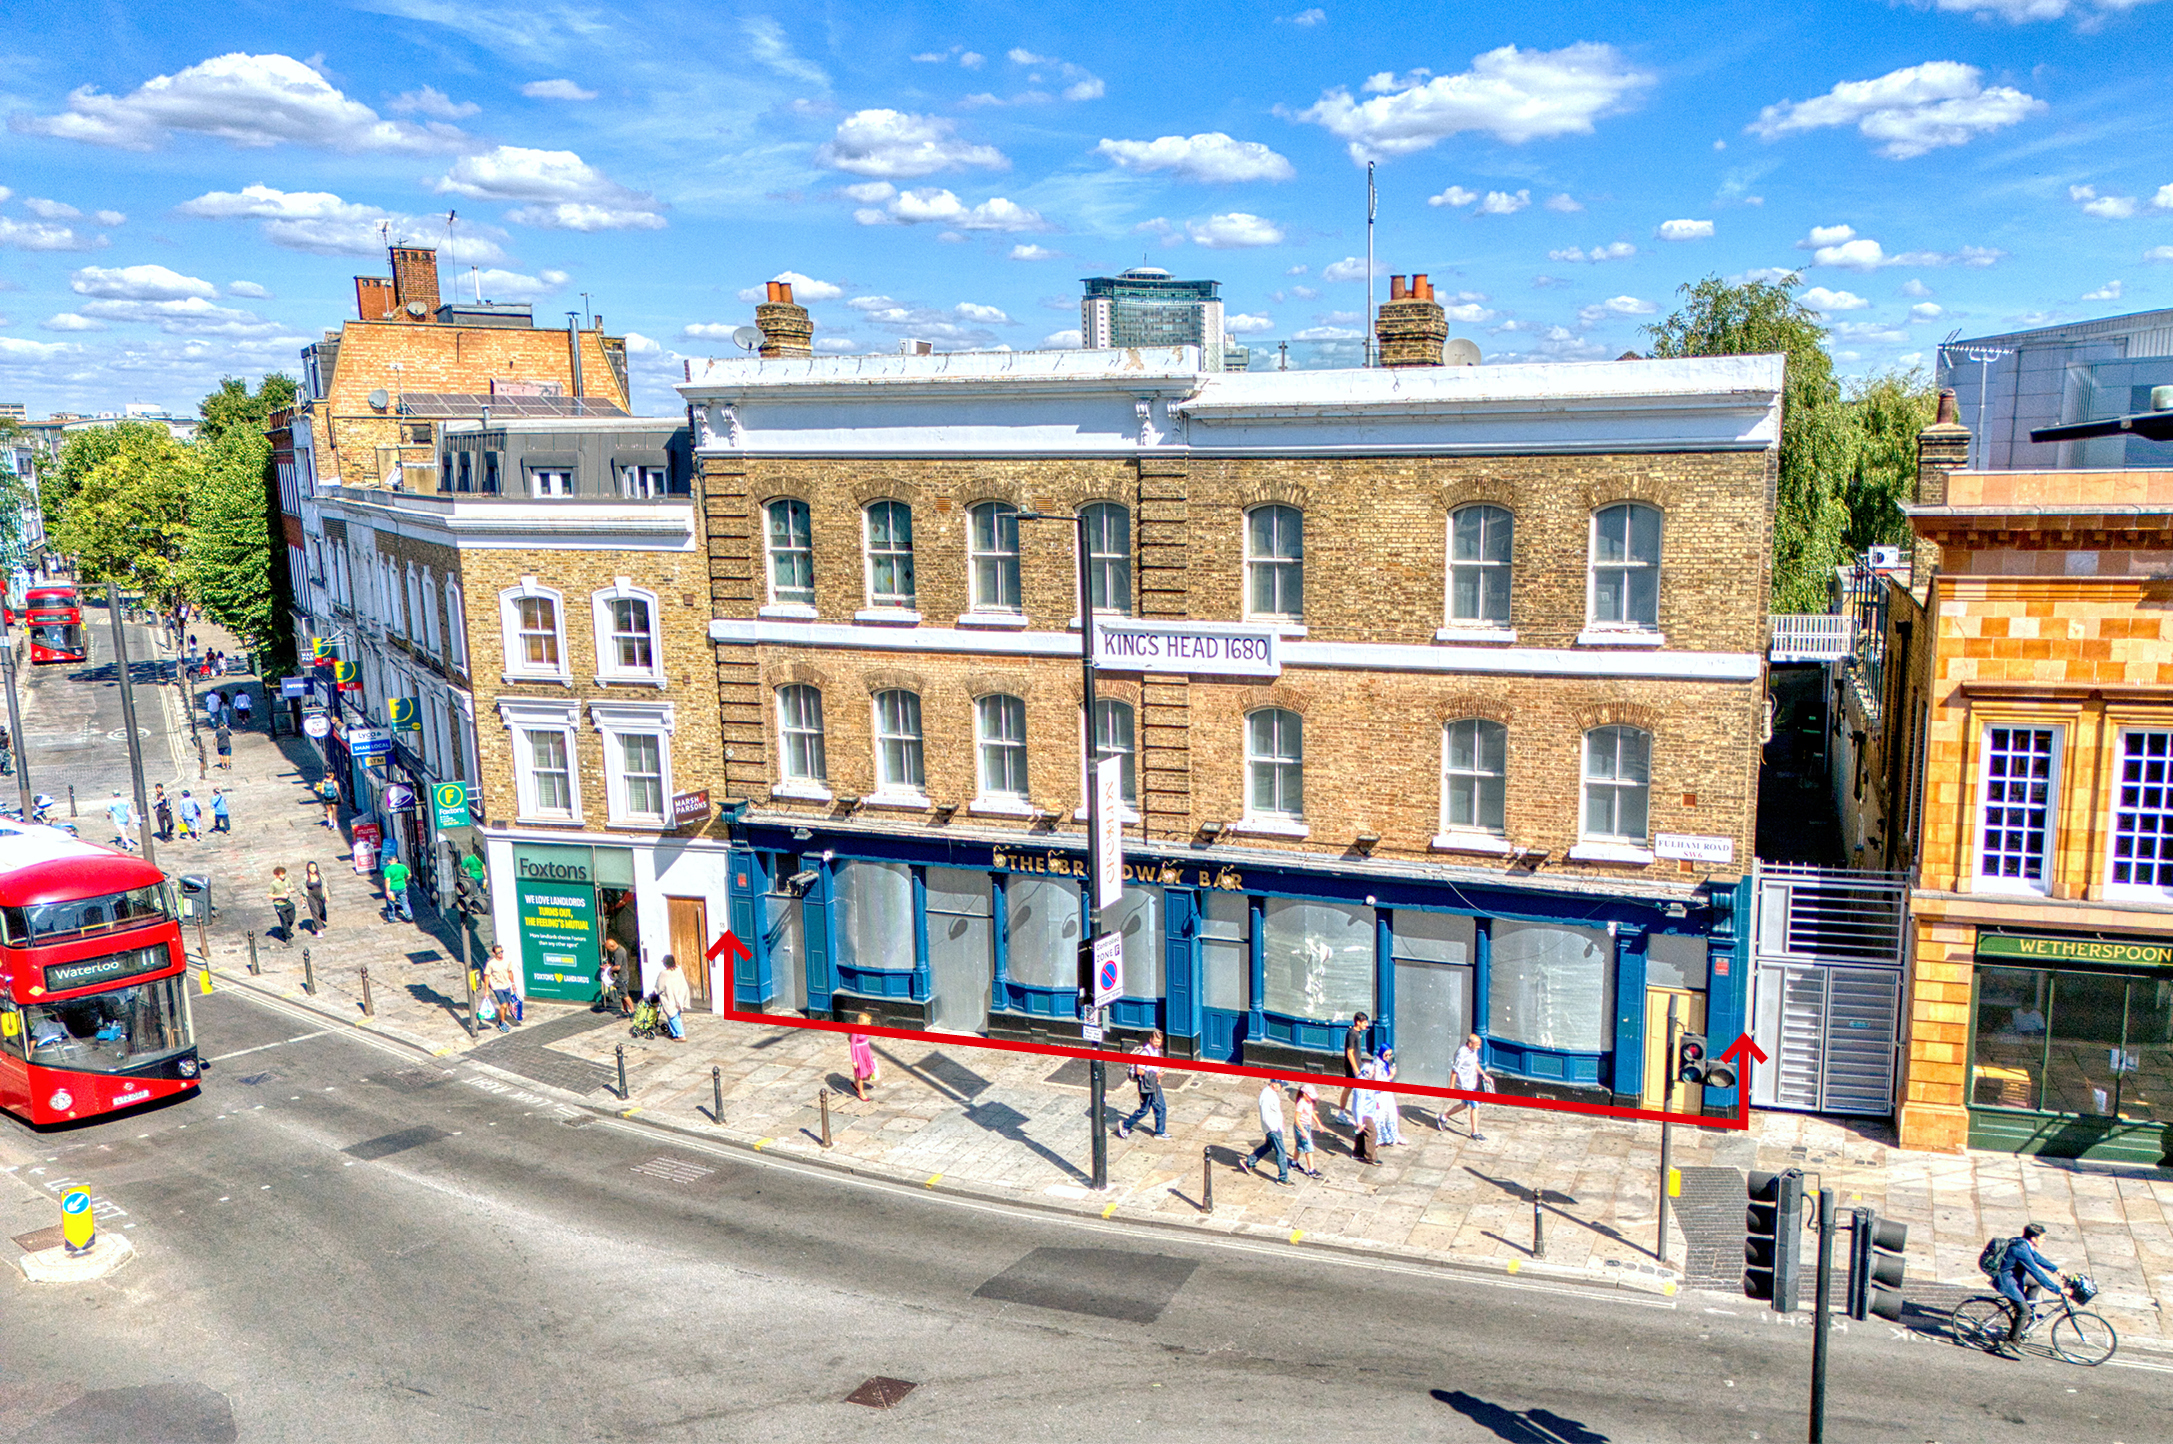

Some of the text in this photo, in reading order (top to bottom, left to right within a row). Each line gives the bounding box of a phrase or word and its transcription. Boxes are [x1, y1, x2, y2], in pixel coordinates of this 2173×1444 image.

[1167, 635, 1219, 659] HEAD
[1225, 637, 1268, 661] 1680
[358, 731, 376, 739] Lyca
[371, 742, 389, 750] LOCAL
[675, 795, 699, 807] MARSH
[676, 800, 707, 815] PARSONS
[439, 807, 465, 815] Foxtons
[1658, 839, 1730, 852] FULHAM ROAD
[1683, 851, 1703, 859] SW6
[519, 857, 587, 881] Foxtons
[1008, 854, 1045, 874] THE
[525, 894, 586, 908] WE LOVE LANDLORDS
[538, 906, 559, 917] TURNS
[524, 916, 536, 927] THE
[1096, 948, 1113, 963] ZONE
[2019, 938, 2172, 962] WETHERSPOON
[55, 949, 155, 981] Waterloo 11
